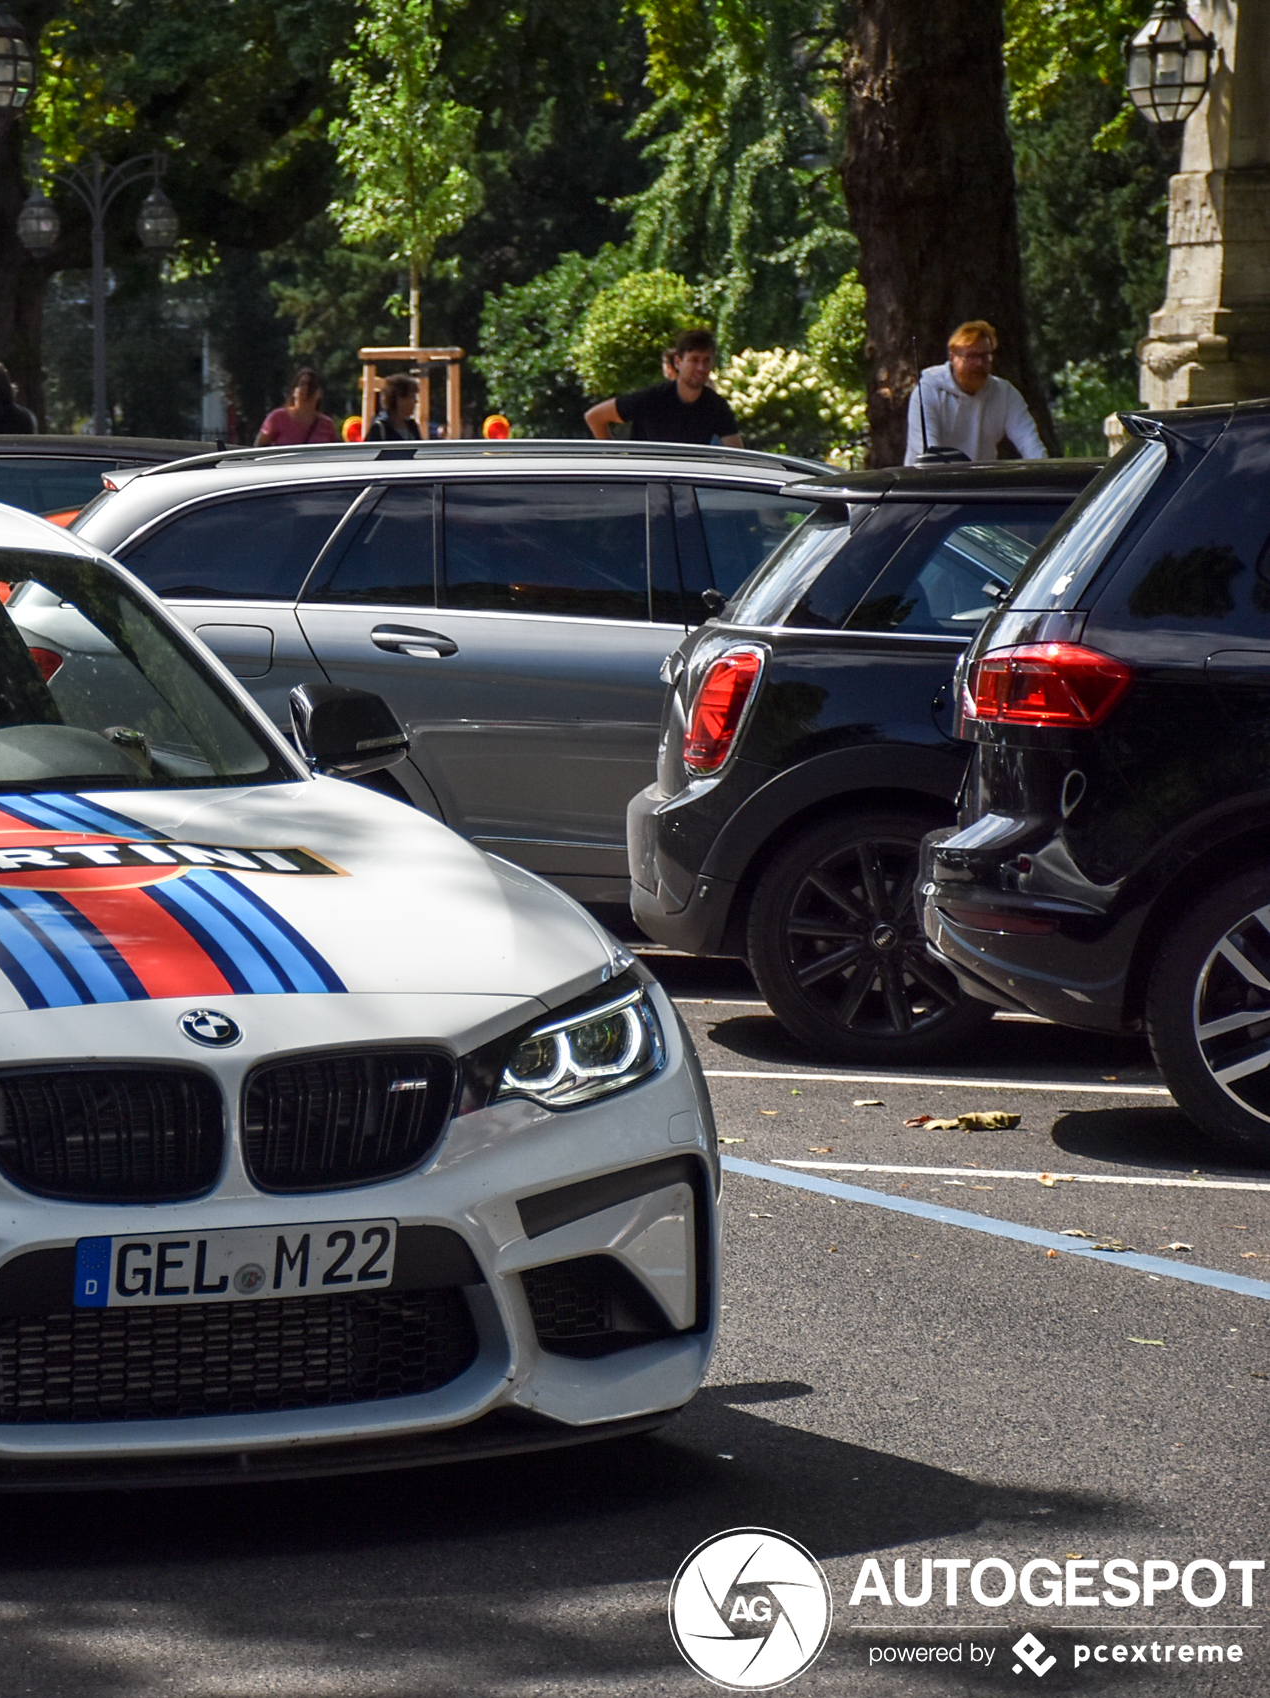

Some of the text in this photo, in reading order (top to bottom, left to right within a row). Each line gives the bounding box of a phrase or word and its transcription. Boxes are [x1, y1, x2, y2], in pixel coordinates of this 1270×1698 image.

[115, 1227, 390, 1297] GEL M 22
[85, 1280, 98, 1295] D
